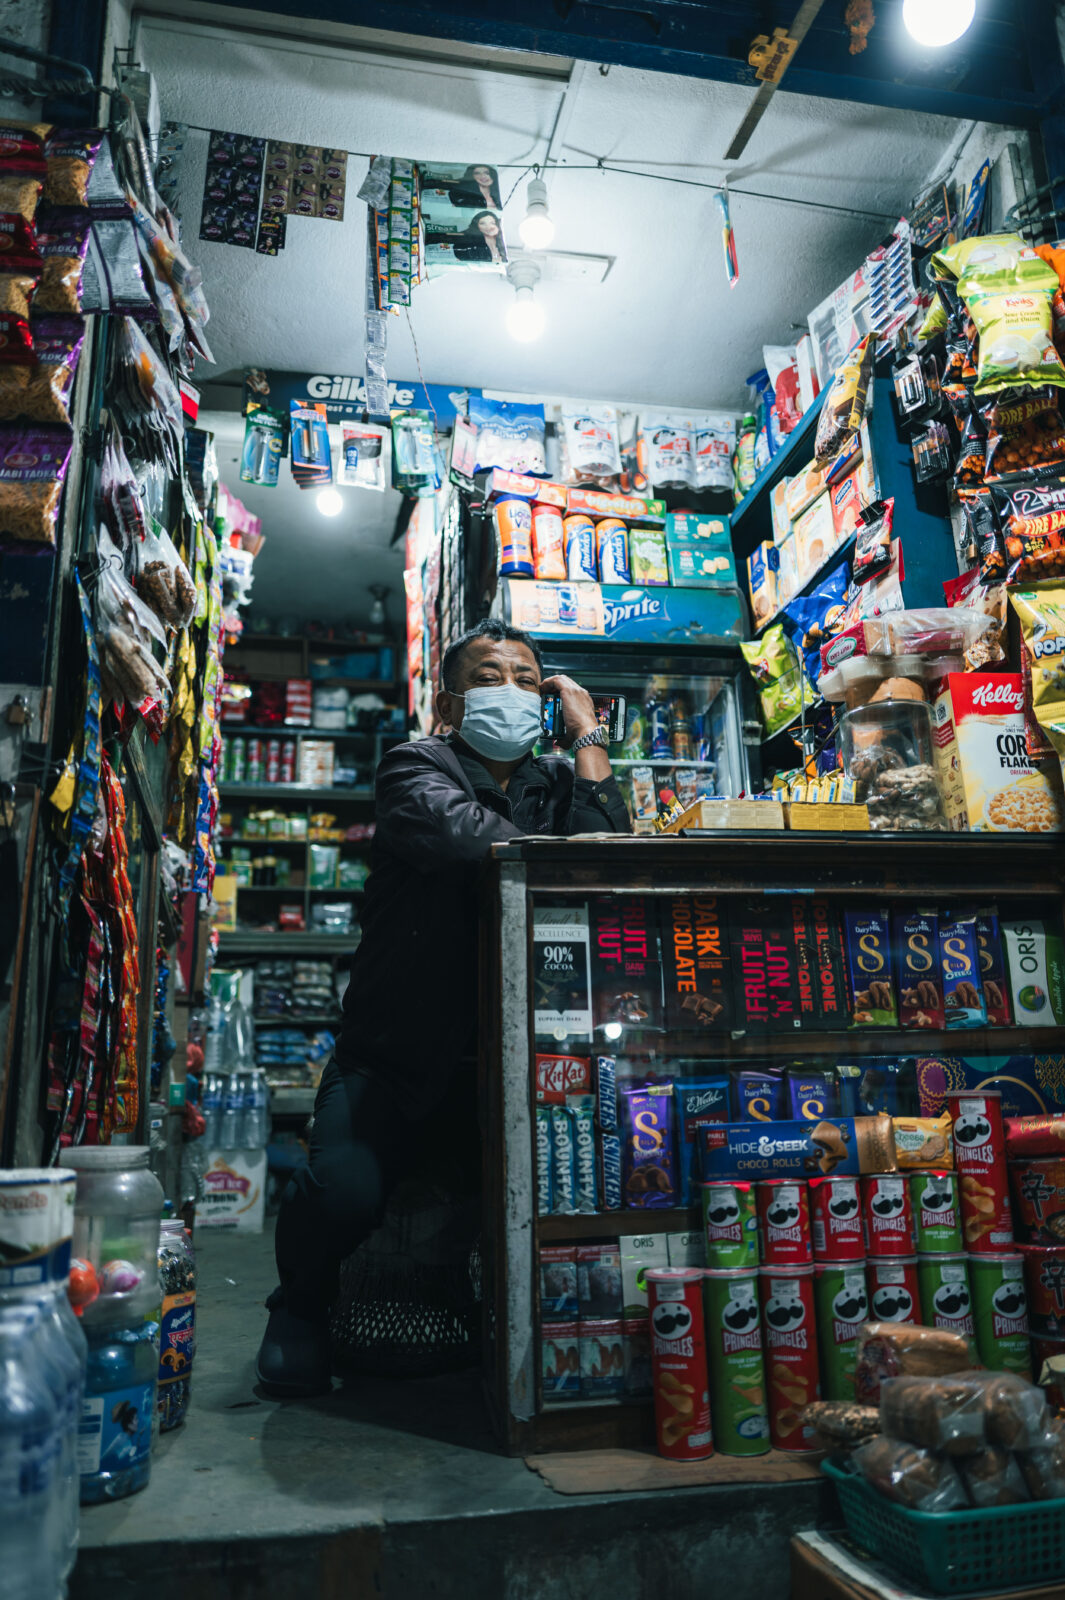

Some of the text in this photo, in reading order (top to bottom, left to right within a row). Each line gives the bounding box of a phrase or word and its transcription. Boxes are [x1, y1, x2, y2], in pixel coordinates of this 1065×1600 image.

[1024, 516, 1049, 536] FIRE
[581, 534, 592, 569] Horlicks
[613, 537, 626, 573] Horlicks
[604, 596, 660, 627] Sprite
[972, 682, 1024, 710] Kellog
[996, 734, 1027, 756] COR
[1000, 757, 1040, 768] FLAKES
[693, 895, 722, 956] DARK
[543, 945, 574, 965] 90%
[671, 895, 697, 993] HOCOLATE
[1014, 926, 1038, 973] ORIS
[543, 963, 574, 971] COCOA
[765, 940, 791, 987] NUT
[741, 945, 769, 1012] FRUIT
[544, 1061, 582, 1091] KitKat
[598, 1058, 617, 1131] SNICKERS
[729, 1136, 809, 1157] HIDE & SEEK
[956, 1144, 994, 1164] PRINGLES
[553, 1119, 573, 1200] BOUNTY
[576, 1119, 595, 1200] BOUNTY
[737, 1157, 801, 1170] CHOCO ROLLS
[603, 1134, 620, 1210] SNICKERS
[829, 1217, 861, 1234] PRINGLES
[872, 1216, 906, 1233] PRINGLES
[921, 1209, 956, 1227] PRINGLES
[633, 1237, 654, 1248] ORIS
[708, 1223, 742, 1242] PRINGLES
[767, 1225, 802, 1243] PRINGLES
[724, 1328, 761, 1353] PRINGLES
[766, 1328, 808, 1350] PRINGLES
[835, 1319, 858, 1343] PRIN
[653, 1335, 694, 1357] PRINGLES
